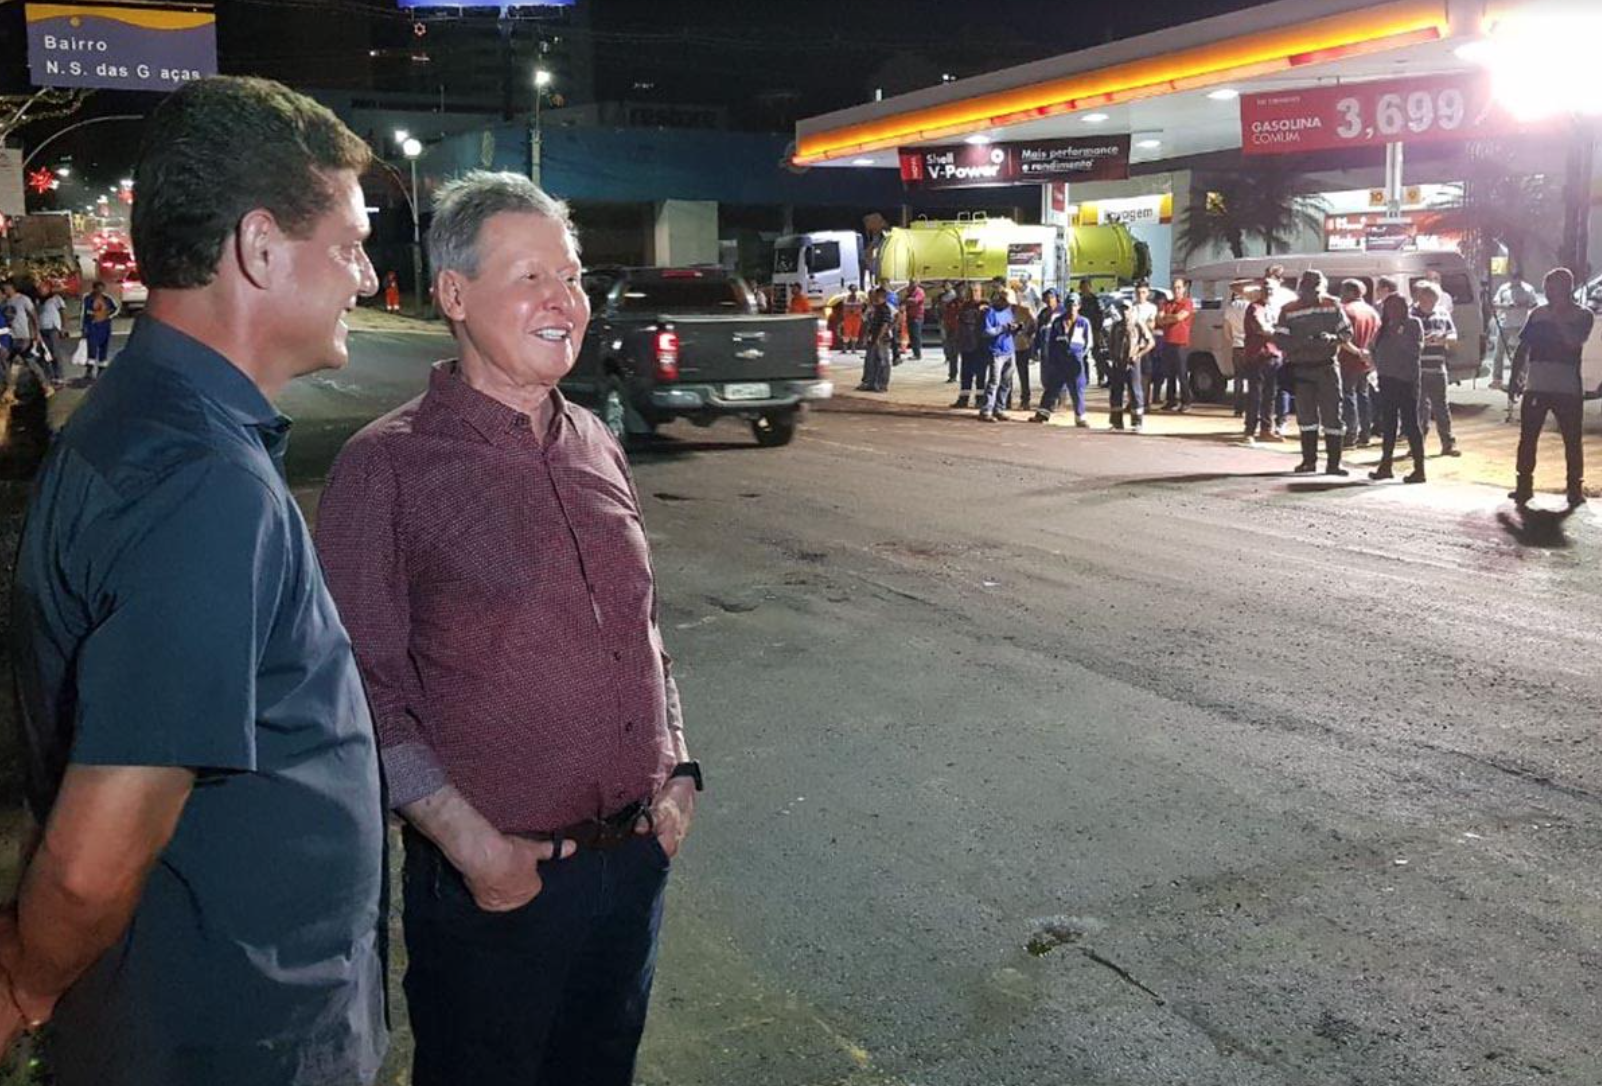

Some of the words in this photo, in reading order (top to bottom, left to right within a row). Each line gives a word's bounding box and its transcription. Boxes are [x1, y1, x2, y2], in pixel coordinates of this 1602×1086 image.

[44, 35, 107, 51] Bairro
[96, 63, 129, 78] das
[1336, 89, 1465, 139] 3,699
[1251, 116, 1322, 132] GASOLINA
[1252, 131, 1300, 145] COMUM
[926, 152, 954, 164] Shell
[1022, 149, 1047, 159] Mais
[1050, 146, 1119, 159] performance
[927, 164, 1000, 179] V-Power
